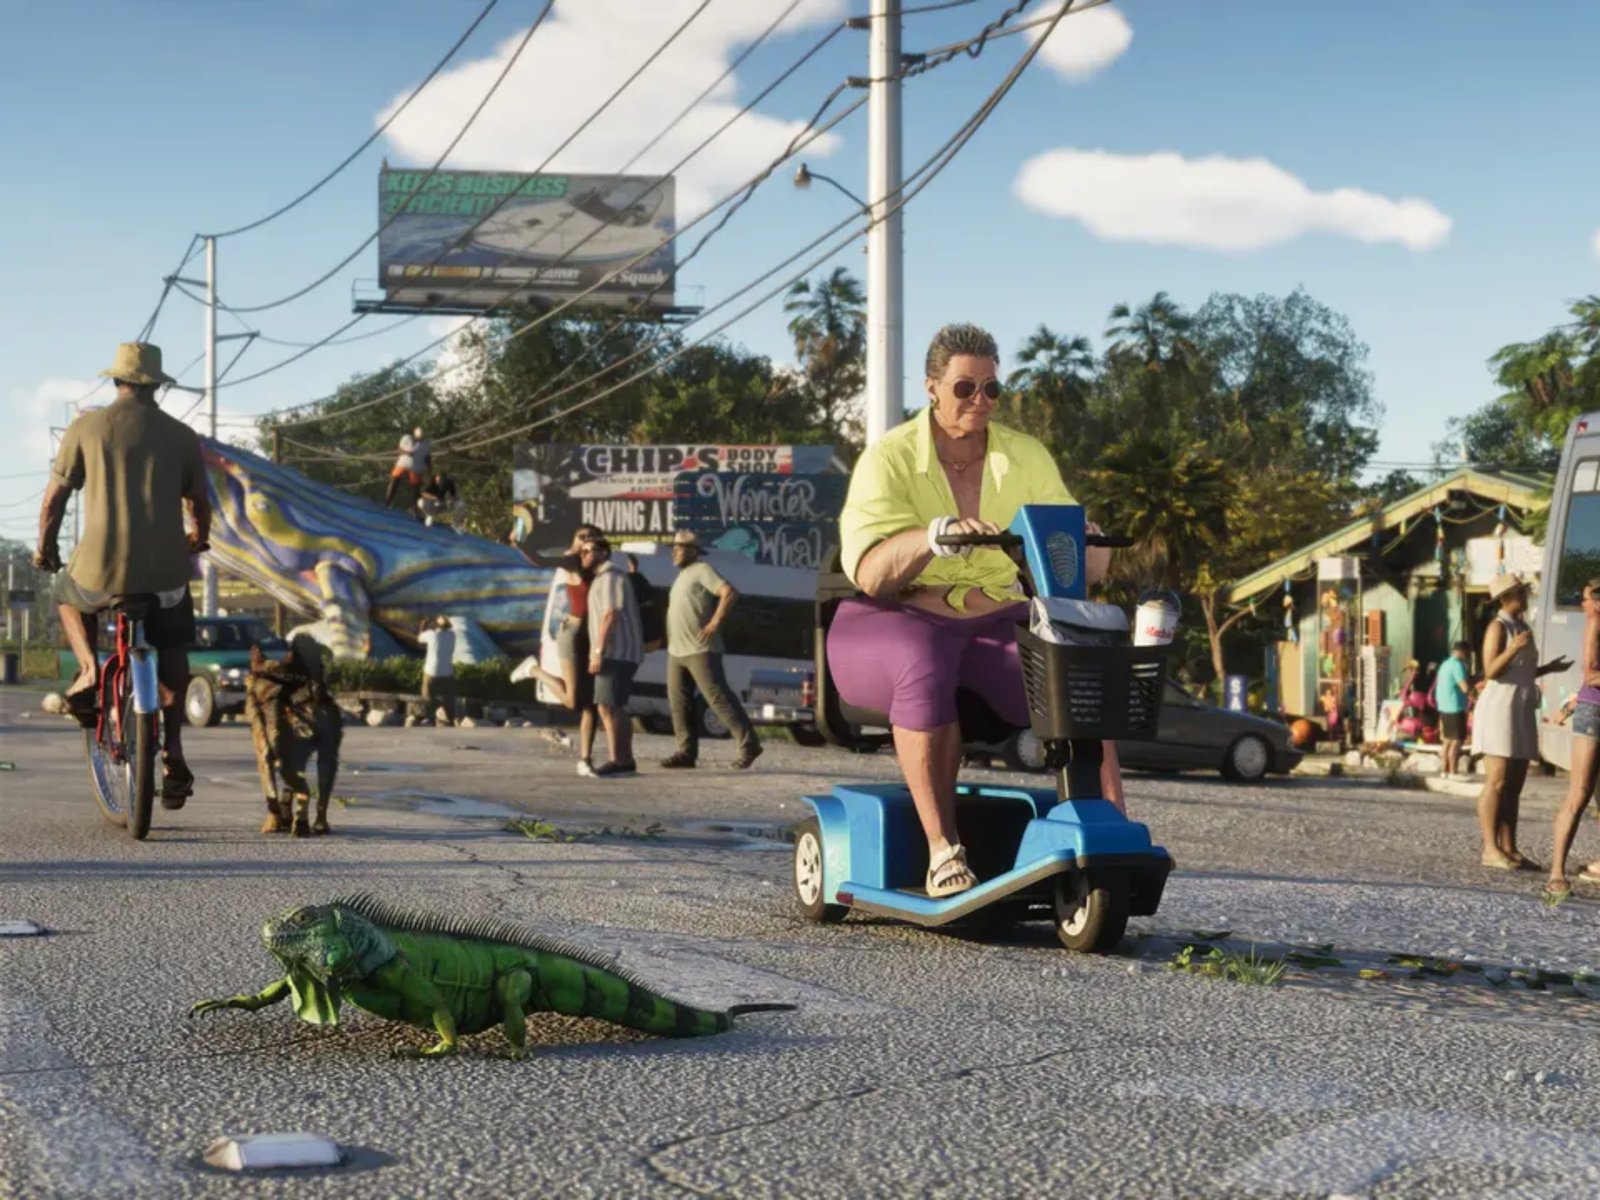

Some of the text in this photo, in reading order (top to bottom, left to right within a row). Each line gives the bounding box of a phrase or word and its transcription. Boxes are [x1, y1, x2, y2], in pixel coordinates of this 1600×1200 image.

[587, 447, 721, 473] CHIP'S
[726, 448, 777, 460] BODY
[726, 461, 777, 473] SHOP
[581, 500, 646, 531] HAVING
[649, 500, 662, 531] A
